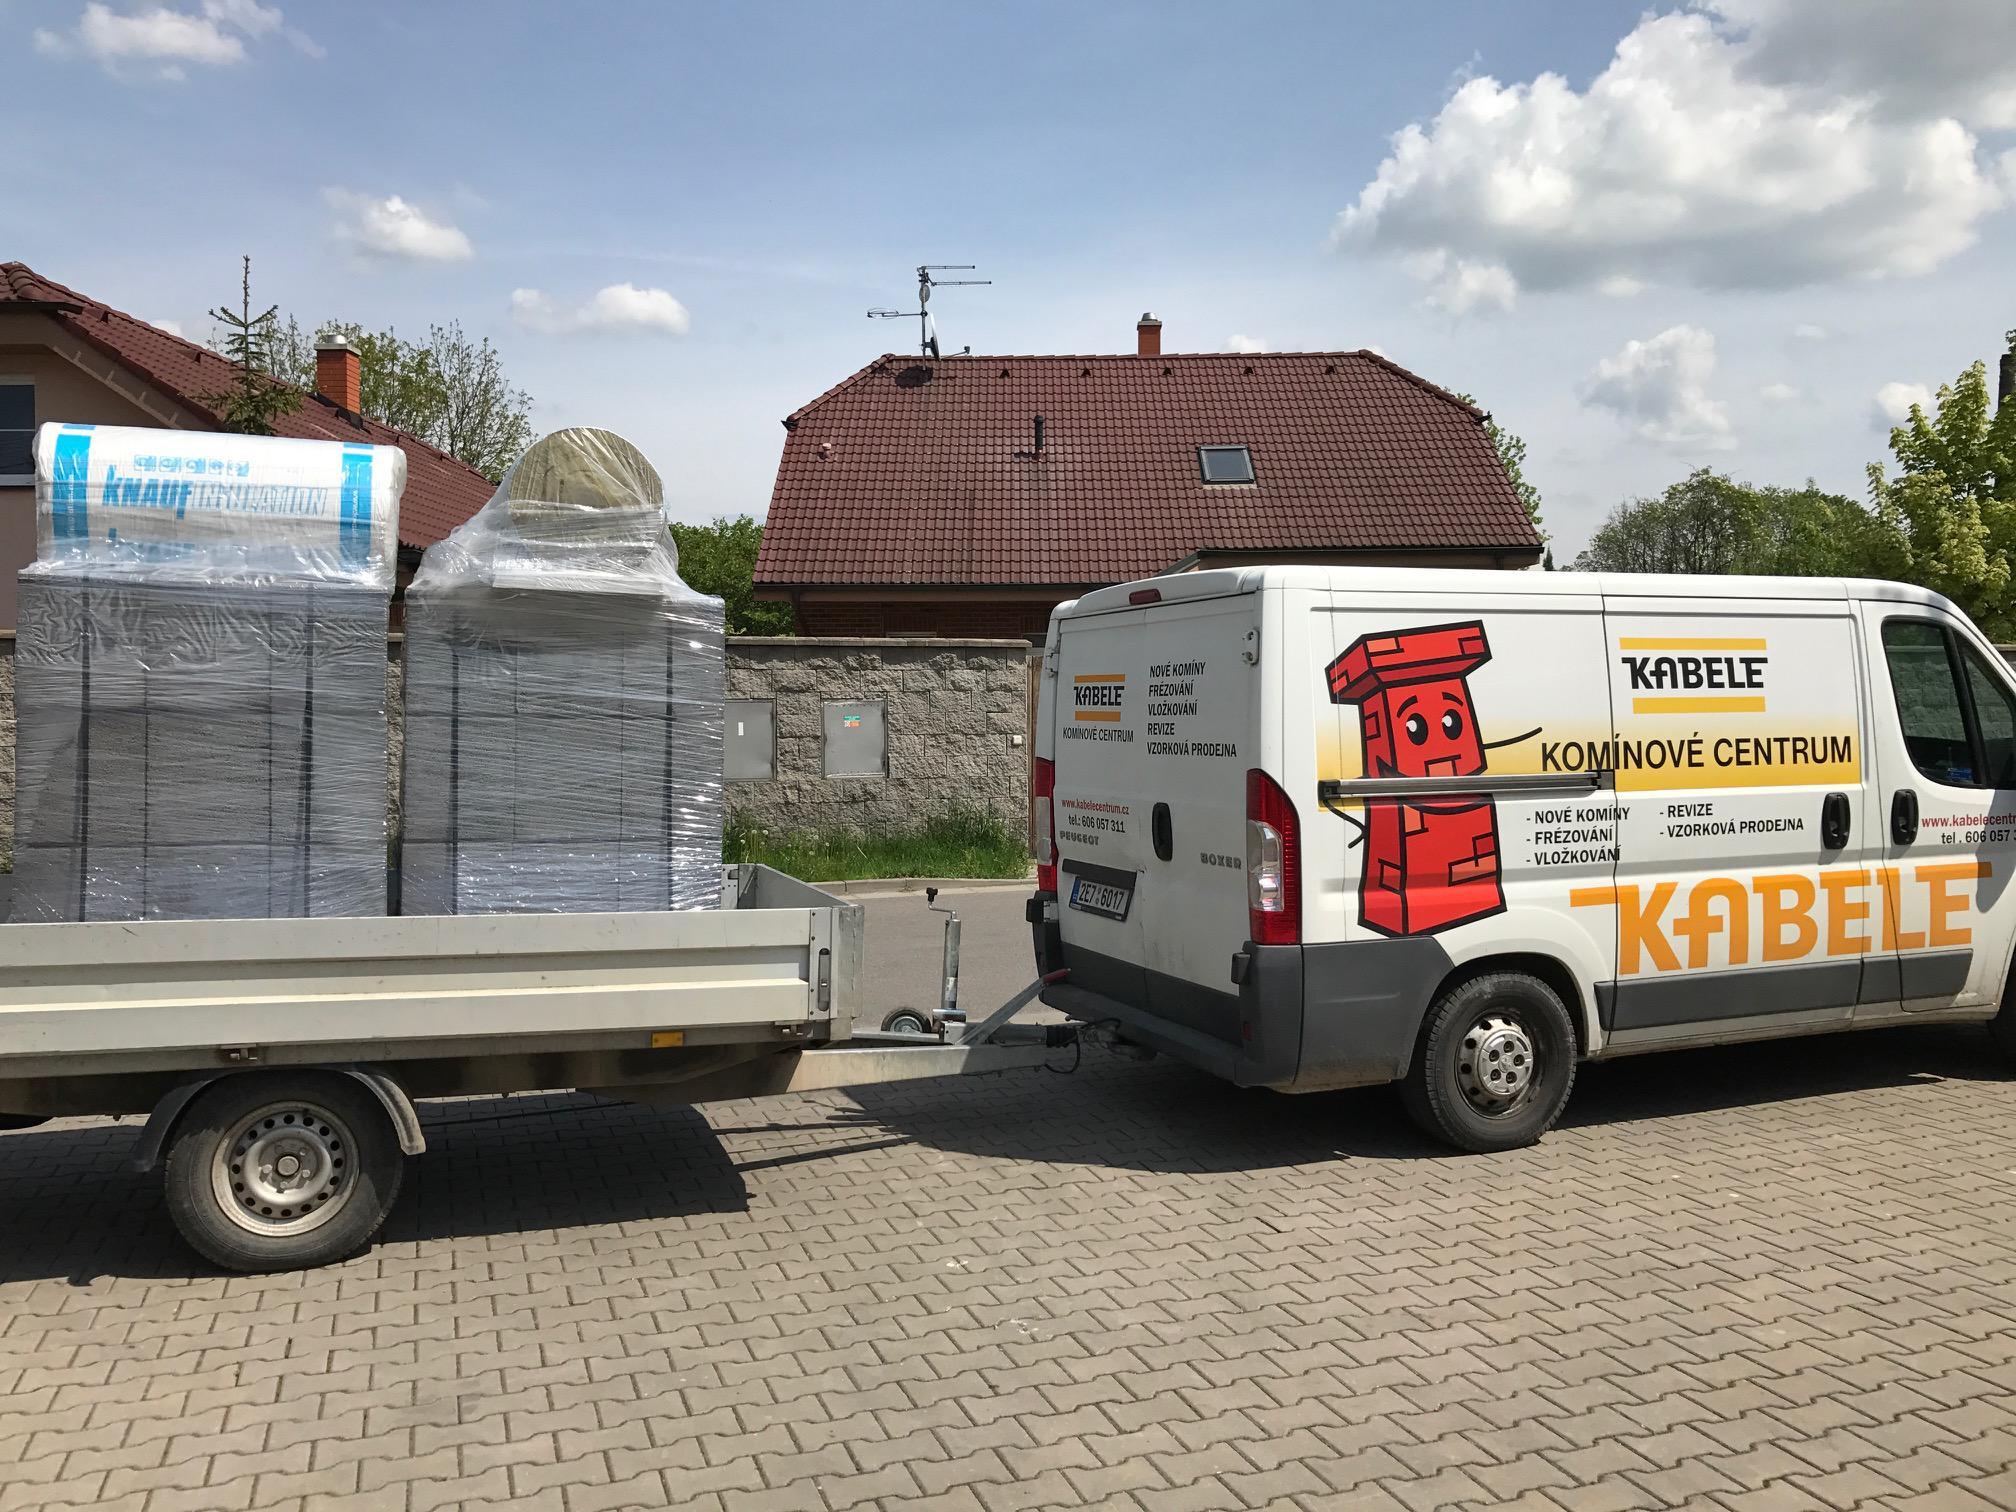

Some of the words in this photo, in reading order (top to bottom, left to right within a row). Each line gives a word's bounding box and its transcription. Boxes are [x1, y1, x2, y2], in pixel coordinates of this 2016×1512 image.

[1150, 661, 1171, 678] NOVÉ
[1172, 659, 1207, 676] KOMÍNY
[1621, 657, 1768, 690] KABELE
[1073, 685, 1125, 707] KABELE
[1148, 681, 1194, 698] FRÉZOVÁNÍ
[1148, 699, 1198, 717] VLOŽKOVÁNÍ
[1063, 724, 1098, 741] KOMÍNOVÉ
[1099, 729, 1134, 743] CENTRUM
[1147, 723, 1175, 736] REVIZE
[1147, 740, 1189, 756] VZORKOVÁ
[1191, 743, 1237, 758] PRODEJNA
[1542, 732, 1705, 772] KOMÍNOVÉ
[1713, 735, 1852, 767] CENTRUM
[1061, 799, 1130, 815] www.kabelecentrum.cz
[1535, 806, 1572, 824] NOVÉ
[1577, 804, 1631, 823] KOMÍNY
[1667, 803, 1713, 818] REVIZE
[1082, 815, 1095, 828] 606
[1096, 818, 1109, 831] 057
[1111, 820, 1125, 833] 311
[1667, 818, 1735, 838] VZORKOVÁ
[1740, 818, 1804, 834] PRODEJNA
[1060, 830, 1099, 845] PEUGEOT
[1535, 825, 1614, 845] FRÉZOVÁNÍ
[1965, 831, 1987, 843] 606
[1990, 830, 2010, 842] 057
[1535, 845, 1622, 865] VLOŽKOVÁNÍ
[1079, 883, 1097, 903] 2E7
[1100, 888, 1125, 910] 6017
[1570, 861, 1993, 976] KABELE
